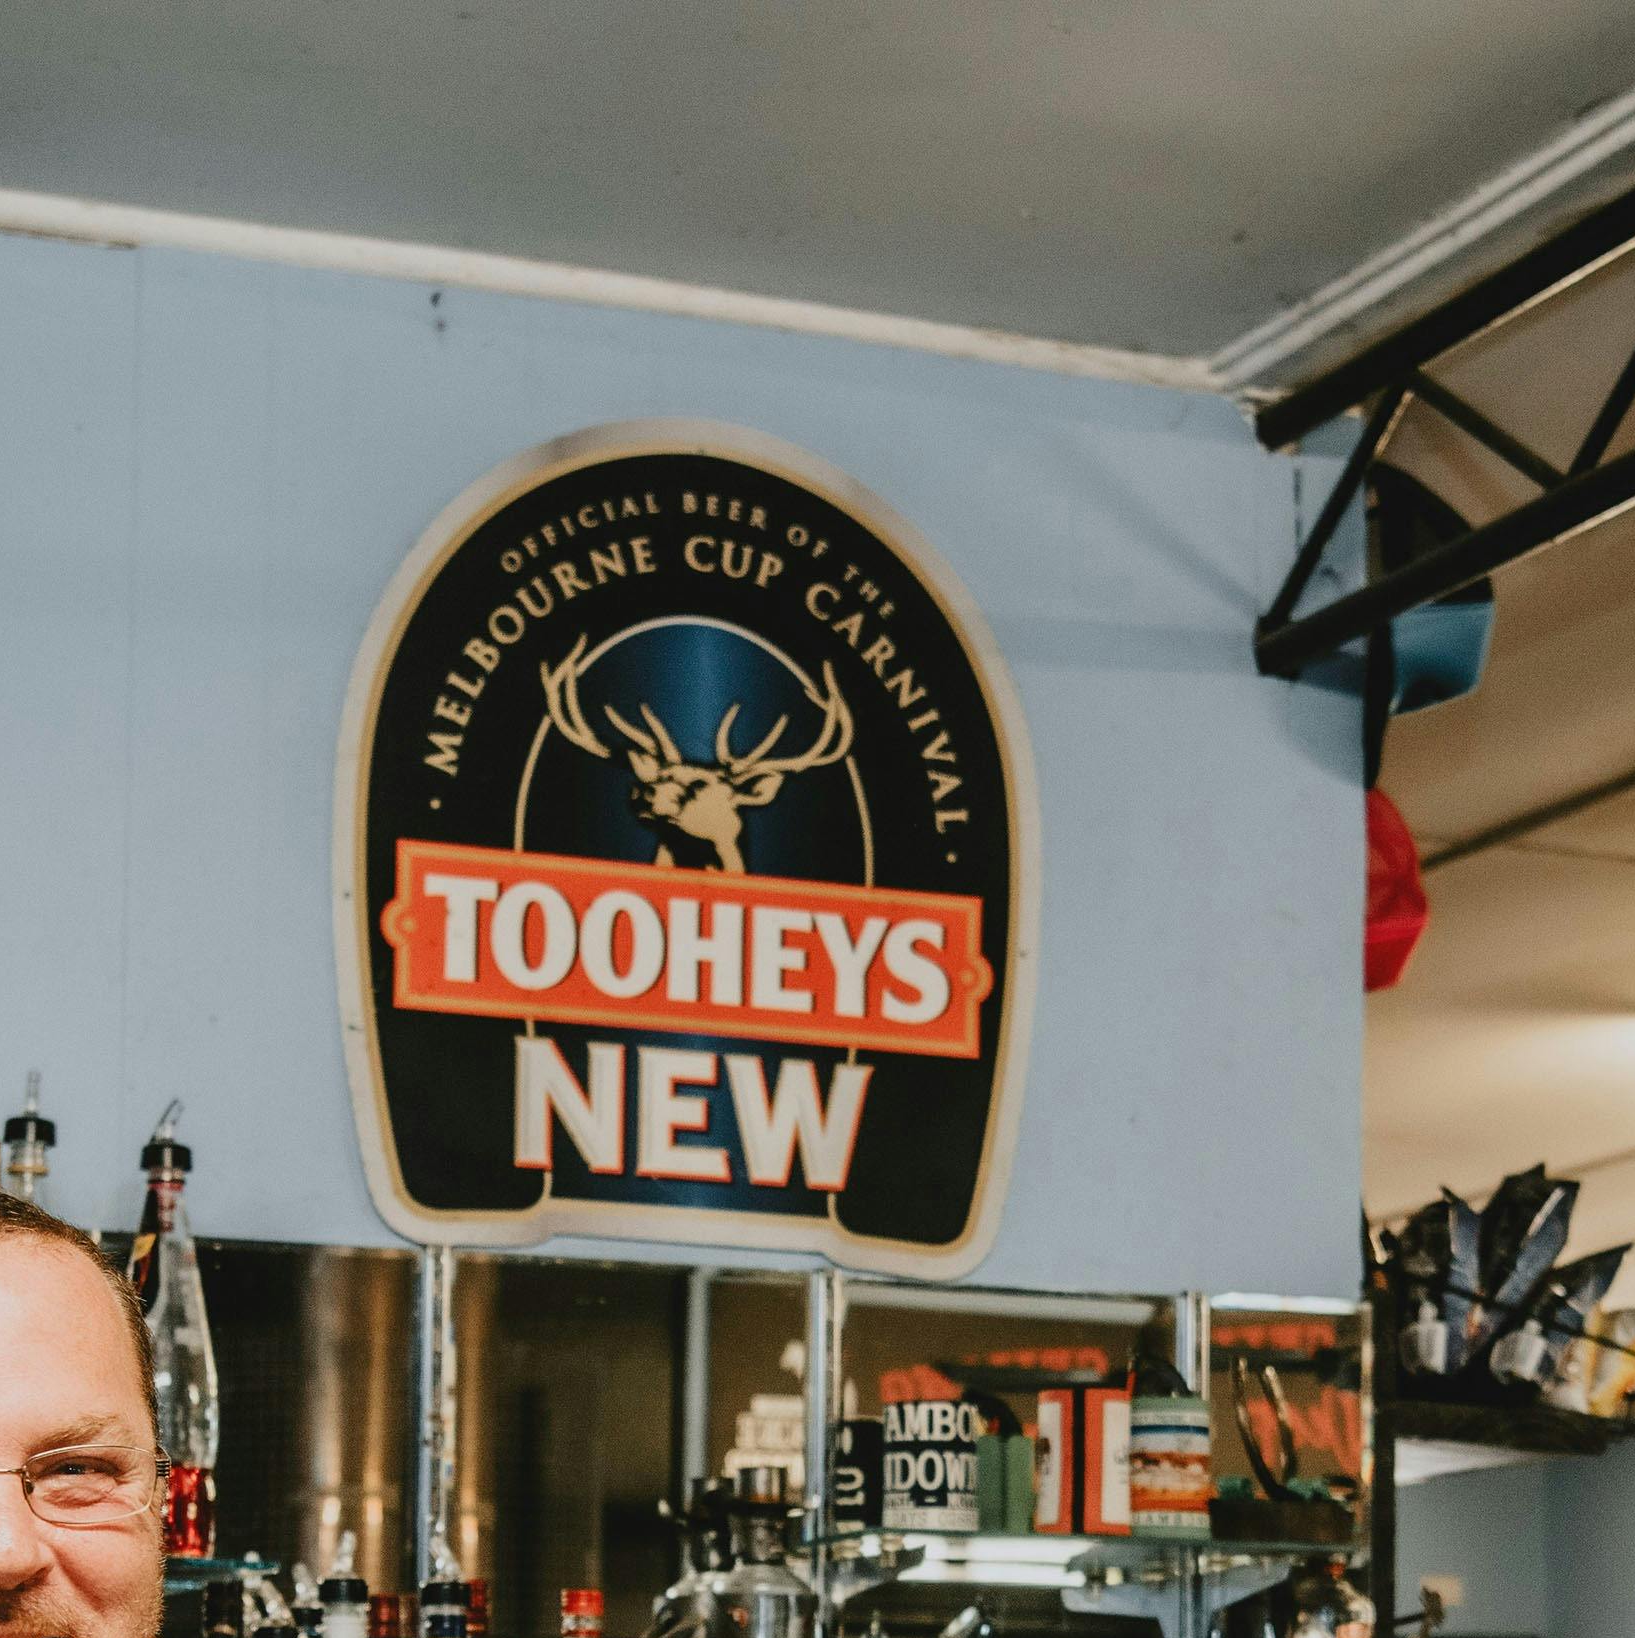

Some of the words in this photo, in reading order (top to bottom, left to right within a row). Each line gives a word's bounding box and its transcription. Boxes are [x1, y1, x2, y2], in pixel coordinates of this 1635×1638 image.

[500, 490, 661, 574] OFFICIAL
[681, 490, 768, 530] BEER
[786, 523, 829, 559] OF
[843, 563, 896, 619] THE
[423, 535, 658, 778] MELBOURNE
[683, 534, 785, 589] CUP
[804, 581, 970, 835] CARNIVAL
[424, 873, 952, 1025] TOOHEYS
[513, 1036, 874, 1192] NEW
